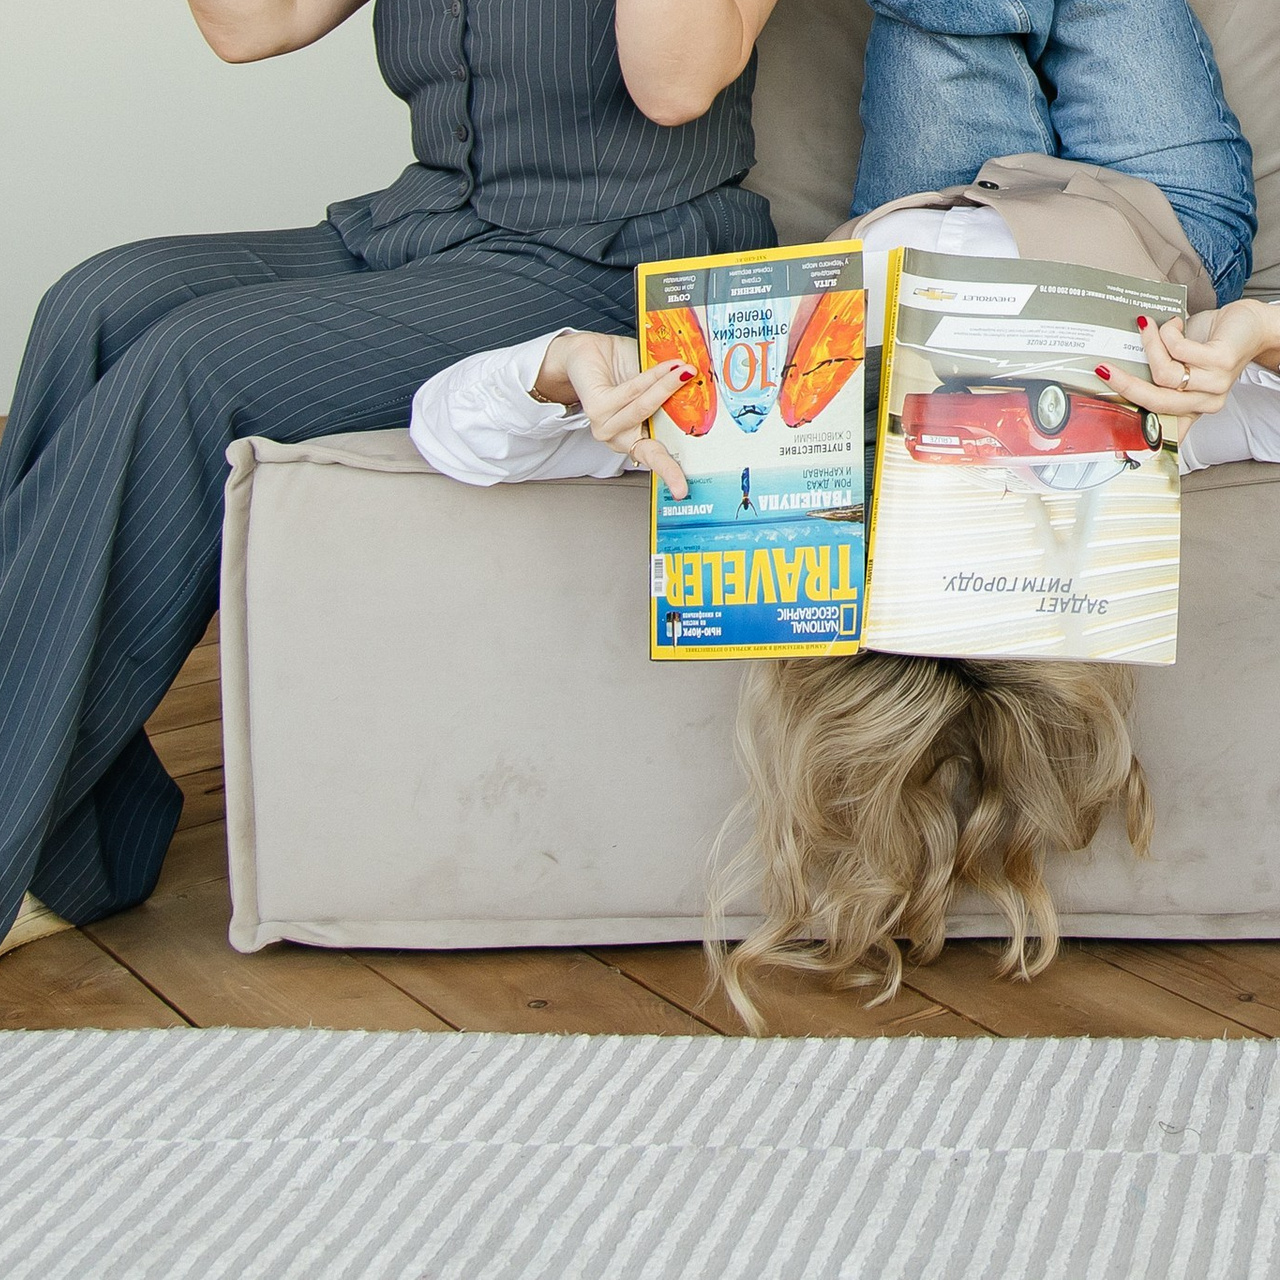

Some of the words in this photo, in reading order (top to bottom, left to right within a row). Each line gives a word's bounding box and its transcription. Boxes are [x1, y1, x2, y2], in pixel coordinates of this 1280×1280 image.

[814, 278, 837, 287] ЯЛТА
[730, 285, 772, 296] АРМЕНИЯ
[667, 294, 691, 303] СОЧИ
[728, 309, 772, 324] отелей
[712, 323, 788, 341] этнических
[1049, 339, 1085, 349] CHEVROLET
[722, 340, 777, 393] 10
[793, 431, 844, 443] ЖИВОТНЫМИ
[846, 430, 851, 439] С
[779, 443, 843, 456] ПУТЕШЕСТВИЕ
[845, 442, 851, 451] В
[802, 467, 844, 478] КАРНАВАЛ
[846, 467, 851, 476] И
[806, 479, 829, 490] ДЖАЗ
[831, 478, 851, 488] РОМ,
[758, 490, 852, 511] ГВАДЕЛУПА
[663, 504, 713, 516] ADVENTURE
[665, 544, 858, 606] TRAVELER
[942, 572, 1018, 592] ГОРОДУ.
[1022, 577, 1073, 593] РИТМ
[1036, 594, 1109, 615] ЗАДАЕТ
[777, 606, 839, 621] GEOGRAPHIC
[682, 627, 722, 638] НЬЮ-ЙОРК
[791, 620, 839, 634] NATIONAL
